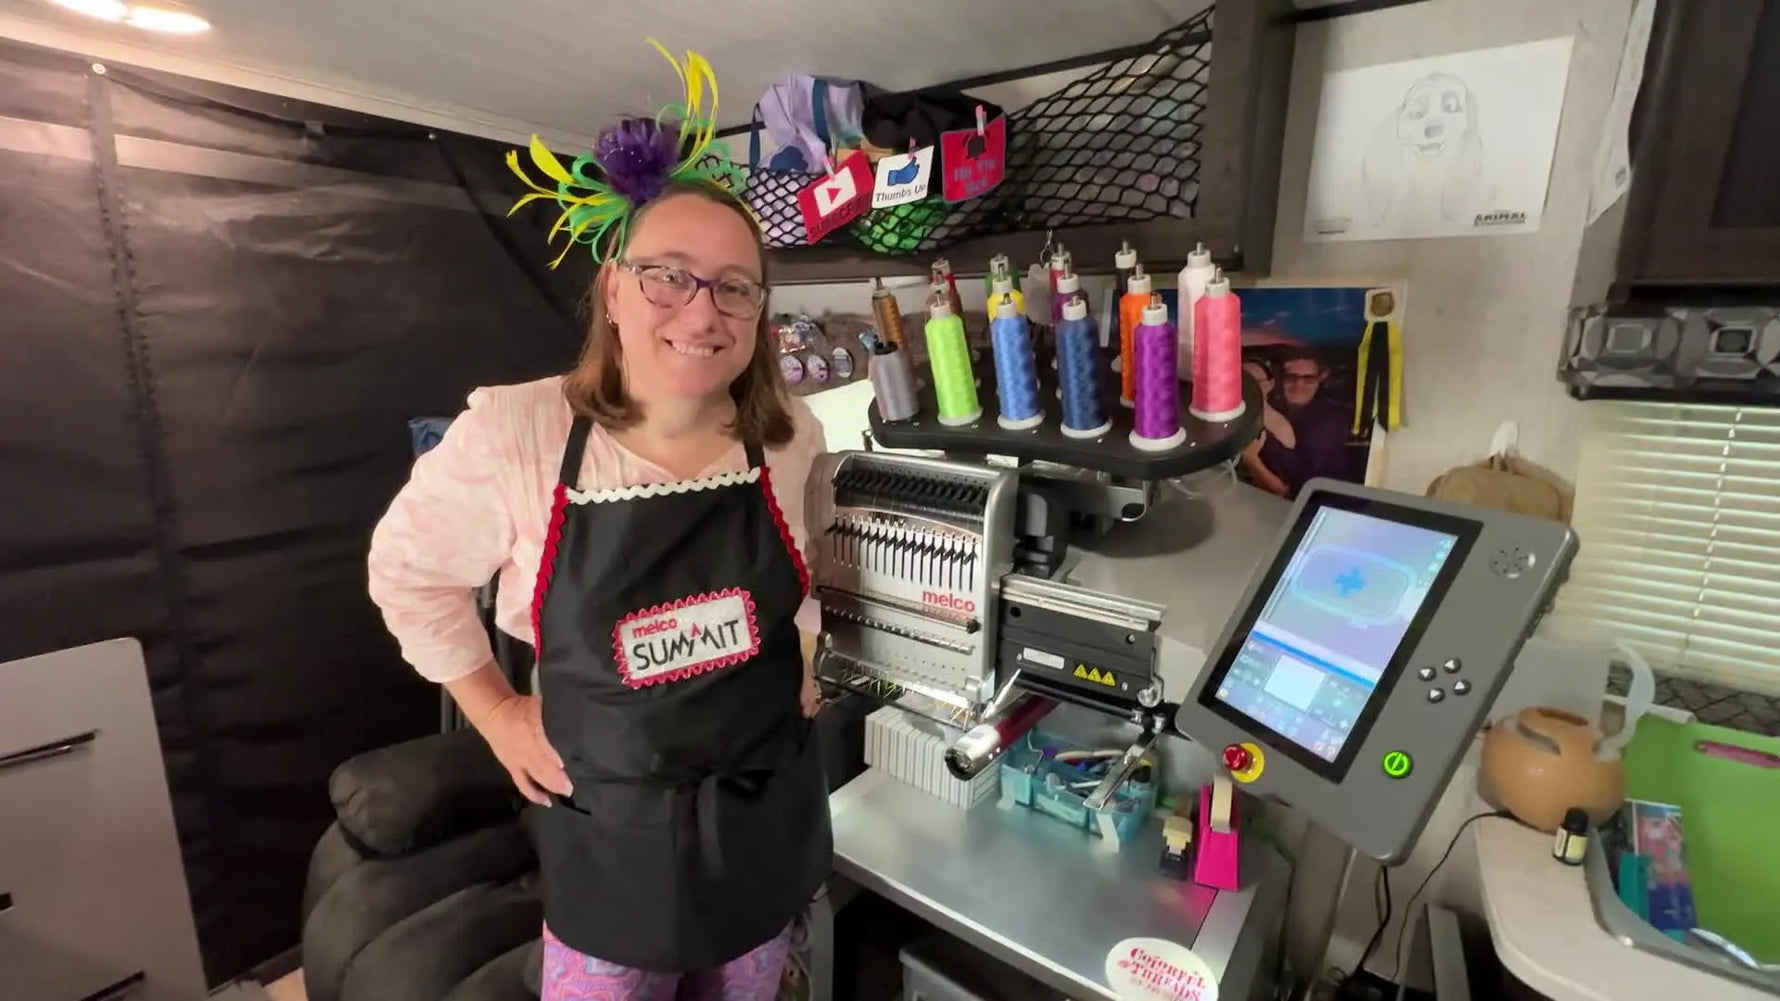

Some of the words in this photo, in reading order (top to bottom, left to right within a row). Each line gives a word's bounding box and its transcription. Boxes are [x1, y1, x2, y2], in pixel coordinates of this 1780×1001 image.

[875, 189, 912, 202] Thumbs
[914, 184, 927, 197] Up
[922, 590, 976, 612] melco
[632, 617, 678, 638] melco
[633, 619, 739, 670] SUMMIT
